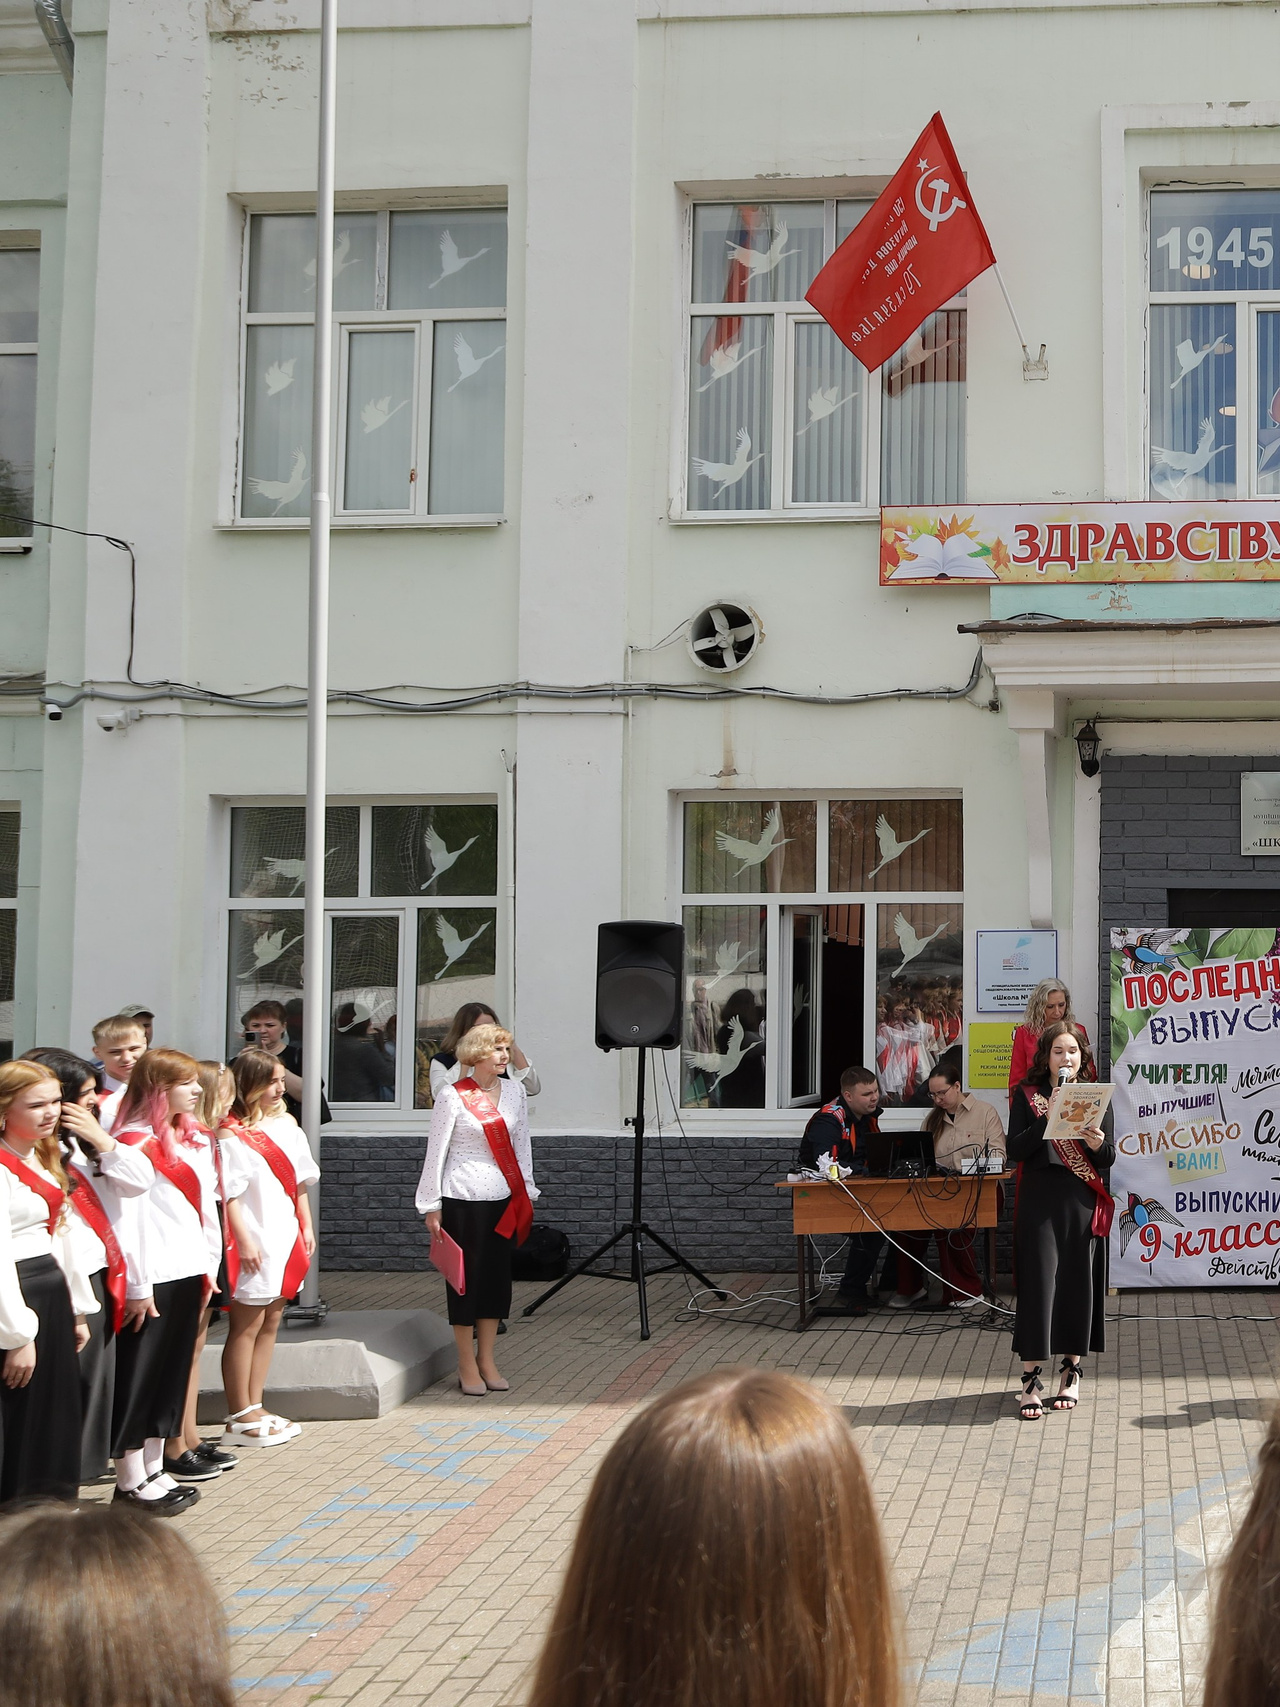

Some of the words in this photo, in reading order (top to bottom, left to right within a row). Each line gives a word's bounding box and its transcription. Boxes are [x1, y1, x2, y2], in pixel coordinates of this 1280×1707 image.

[1156, 226, 1274, 270] 1945
[1127, 1064, 1228, 1085] УЧИТЕЛЯ!
[1138, 1104, 1157, 1118] ВЫ
[1160, 1093, 1215, 1115] ЛУЧШИЕ!
[1118, 1122, 1241, 1156] СПАСИБО
[1176, 1152, 1218, 1170] ВАМ!
[1139, 1223, 1163, 1263] 9
[1173, 1219, 1280, 1259] класс
